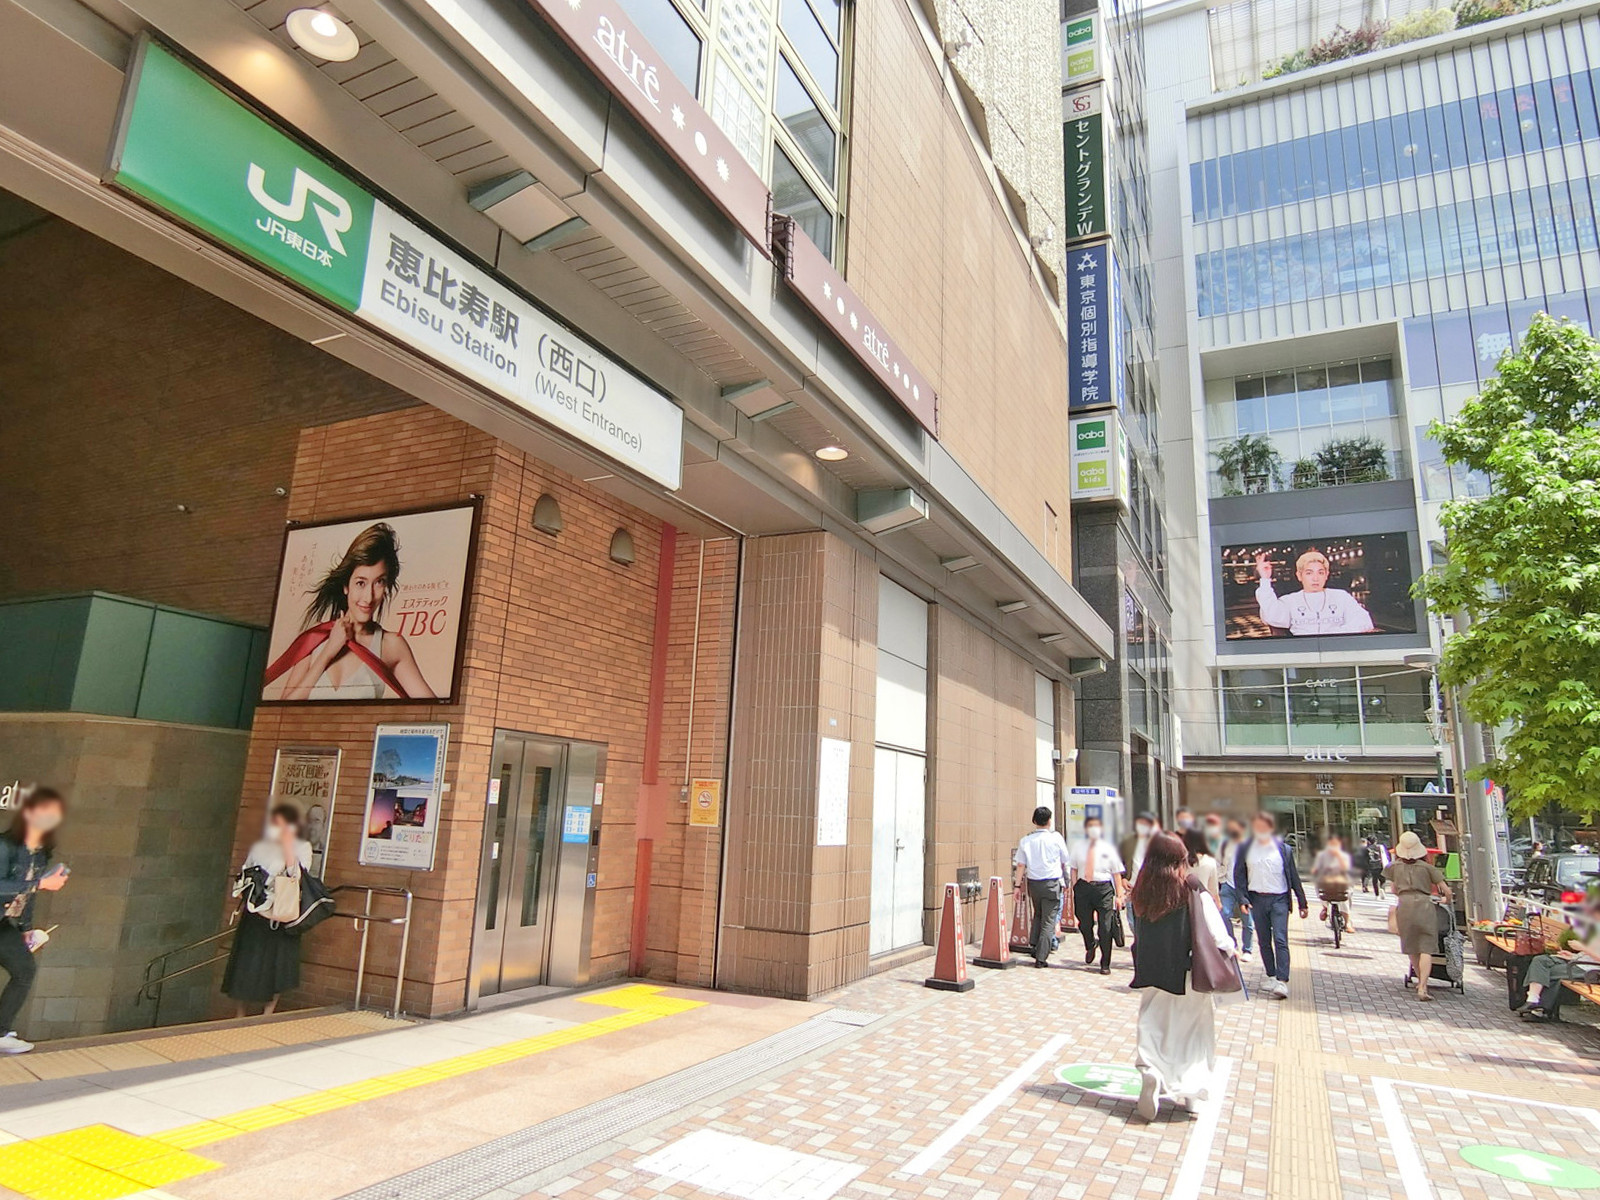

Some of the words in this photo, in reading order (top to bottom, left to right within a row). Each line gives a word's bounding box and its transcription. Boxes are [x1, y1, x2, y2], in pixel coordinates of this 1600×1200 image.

[595, 15, 660, 106] atré
[247, 162, 352, 257] JR
[1075, 120, 1093, 236] セントグランデW
[255, 216, 334, 268] JR東日本
[380, 279, 443, 334] Ebisu
[450, 322, 518, 378] Station
[385, 232, 520, 350] 恵比寿駅
[1079, 273, 1099, 402] 東京個別指導学院
[535, 371, 578, 415] (West
[582, 402, 643, 453] Entrance)
[396, 609, 448, 637] TBC
[401, 595, 449, 609] エステティック
